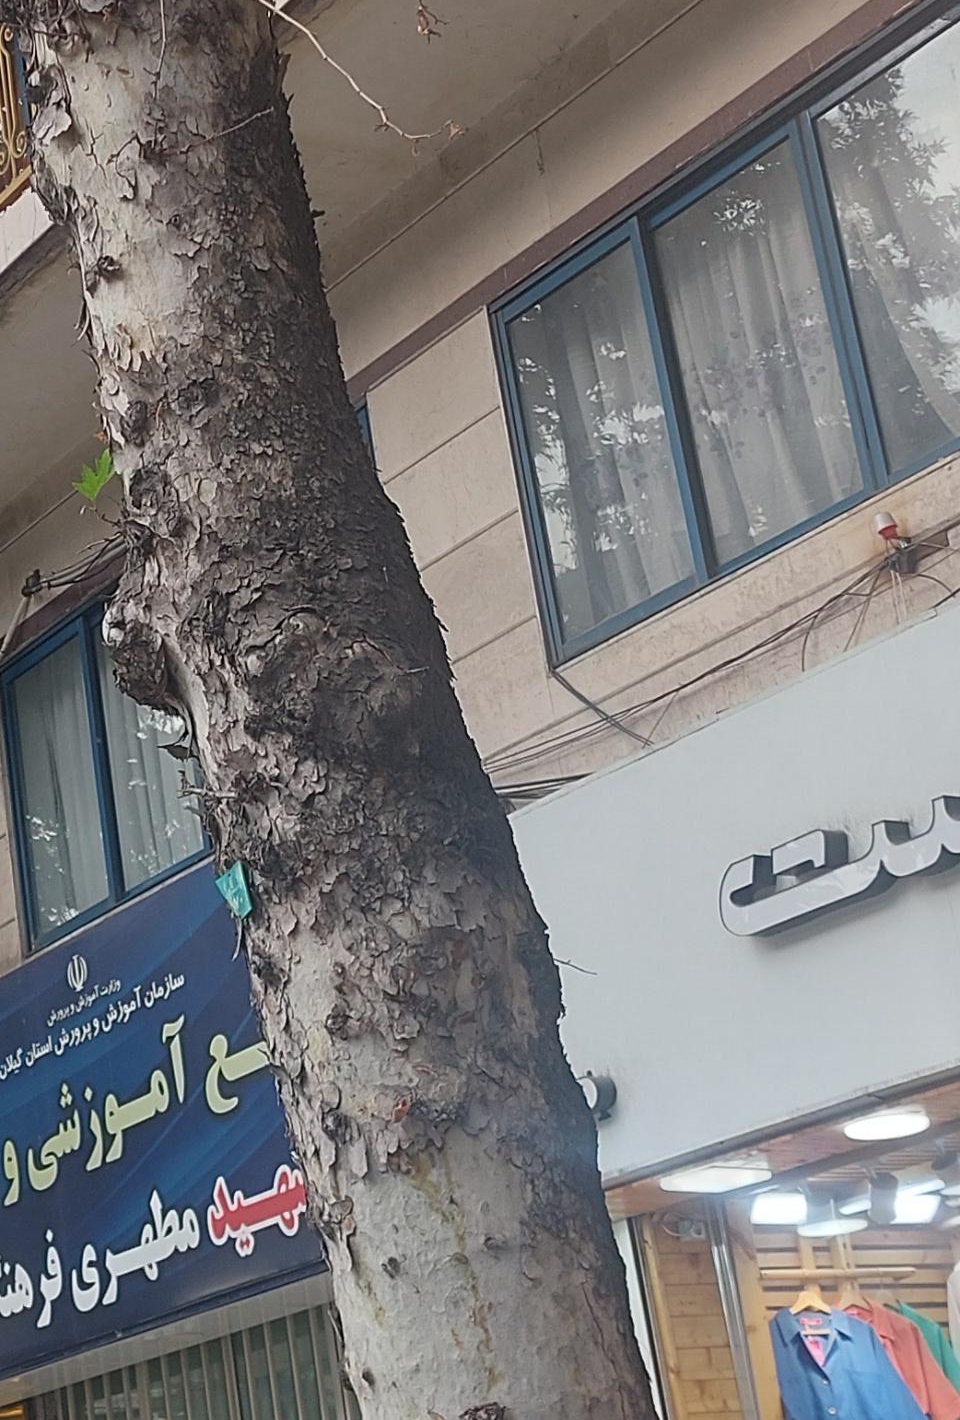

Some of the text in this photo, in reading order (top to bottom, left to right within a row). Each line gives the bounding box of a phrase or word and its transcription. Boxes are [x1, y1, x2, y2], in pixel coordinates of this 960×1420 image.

[720, 794, 960, 937] ست
[76, 985, 100, 1013] آموزش
[101, 979, 121, 996] وزارت
[144, 973, 185, 1007] سازمان
[47, 1007, 71, 1027] پرورش
[101, 985, 142, 1032] آموزش
[54, 1023, 92, 1055] پرورش
[93, 1018, 100, 1037] و
[25, 1036, 53, 1066] استان
[27, 1014, 186, 1192] آموزشی
[3, 1139, 20, 1206] و
[71, 1189, 201, 1312] مطهری
